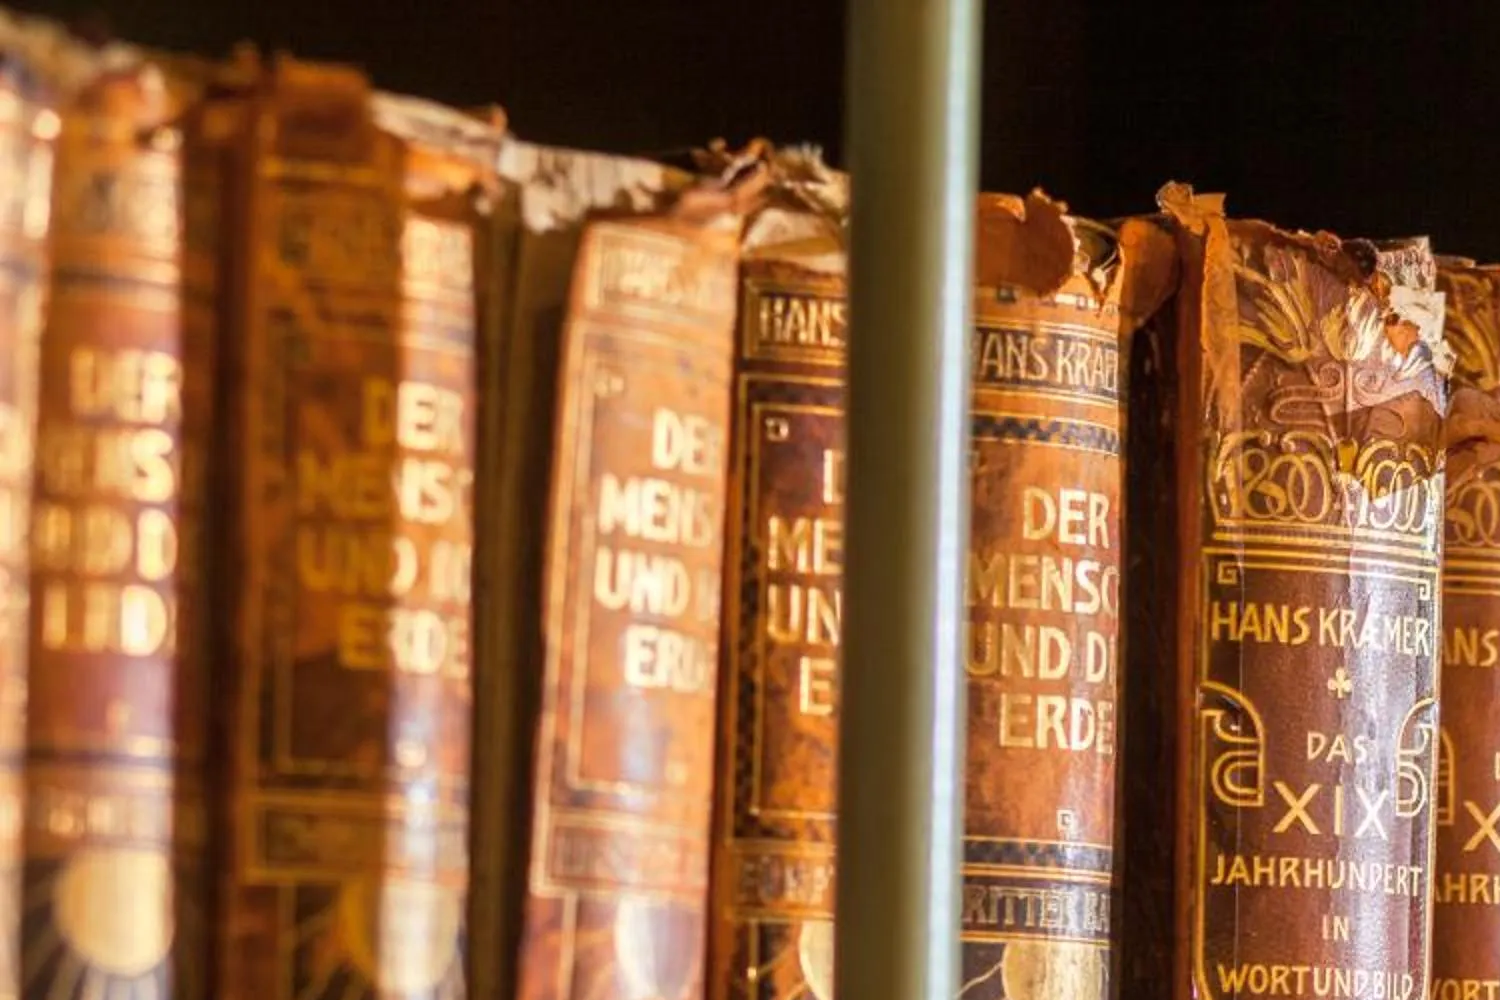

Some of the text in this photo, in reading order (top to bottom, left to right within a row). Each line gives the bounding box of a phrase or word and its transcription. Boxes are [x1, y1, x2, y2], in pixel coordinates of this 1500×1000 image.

[1023, 486, 1109, 549] DER
[1211, 601, 1311, 646] HANS
[964, 620, 1071, 681] UND
[1000, 692, 1113, 754] ERDE
[1306, 731, 1368, 765] DAS
[1272, 781, 1389, 840] XIX
[1211, 854, 1423, 897] JAHRHUNDERT
[1321, 913, 1350, 941] IN
